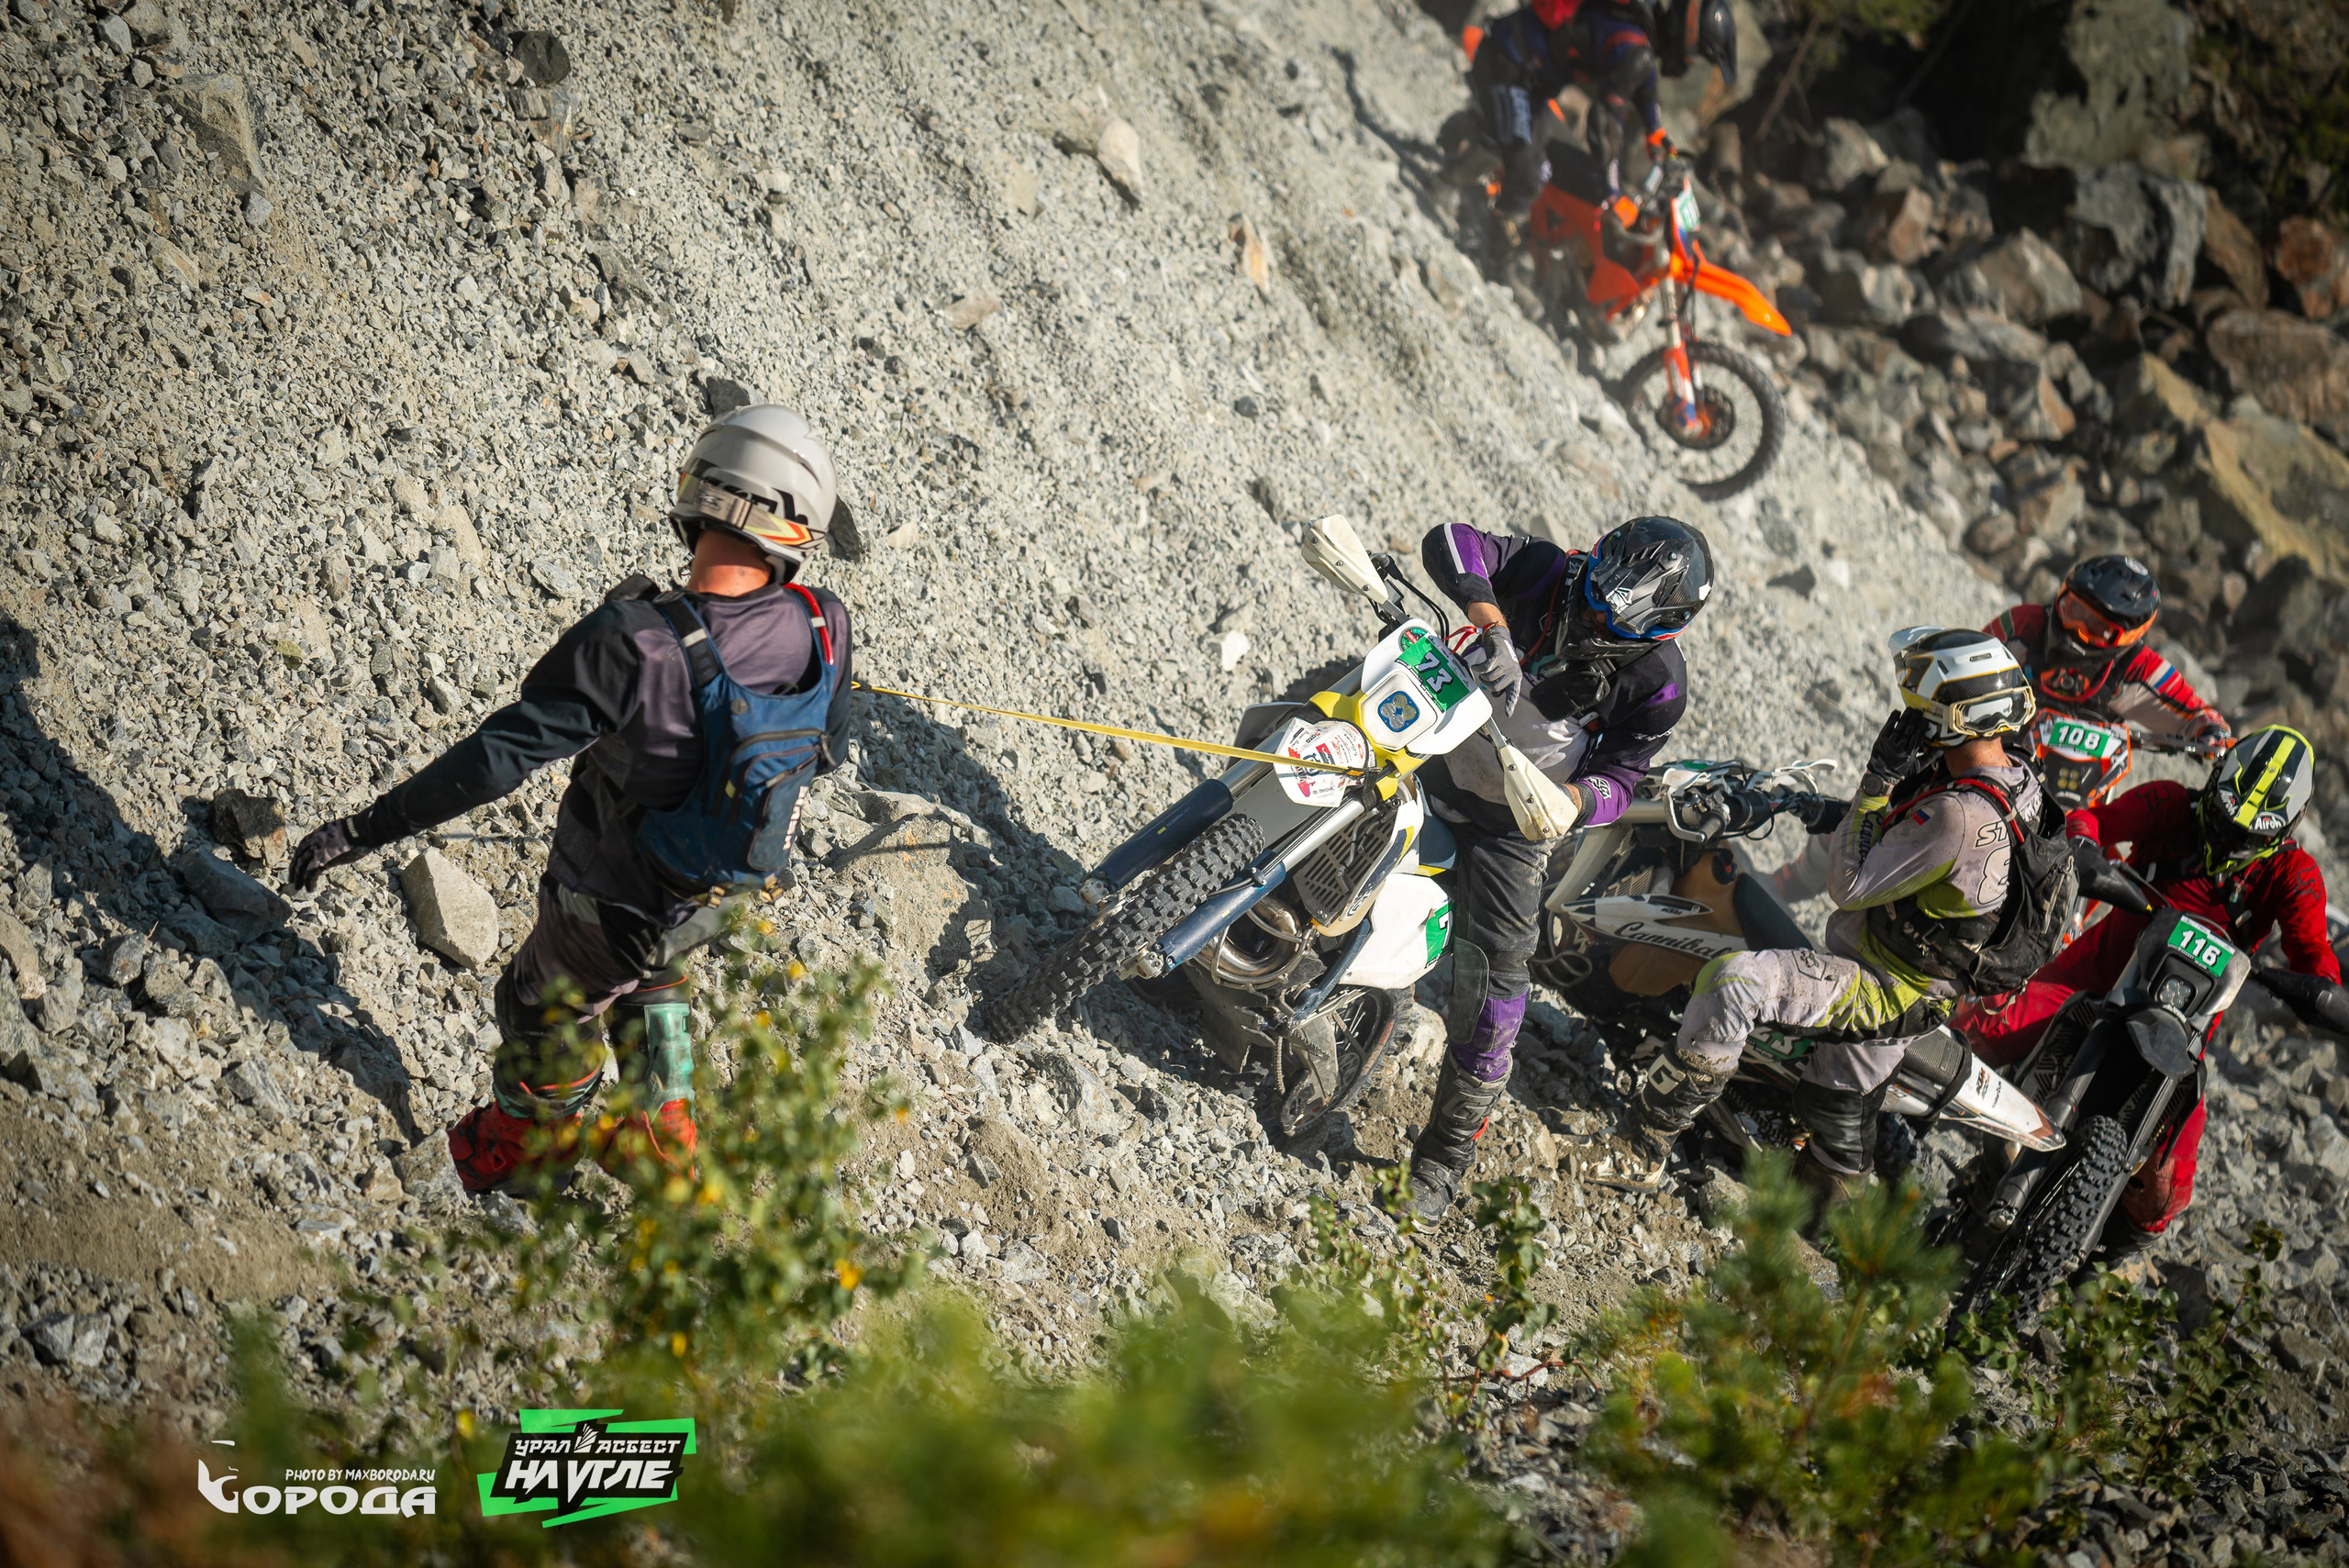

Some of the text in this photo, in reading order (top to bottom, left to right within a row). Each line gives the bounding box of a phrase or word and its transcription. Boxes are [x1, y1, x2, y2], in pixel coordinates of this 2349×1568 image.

[1414, 651, 1453, 695] 73
[2057, 724, 2101, 751] 108
[2254, 815, 2282, 830] Airoh
[1614, 921, 1732, 960] Cannibal
[2179, 929, 2221, 967] 116
